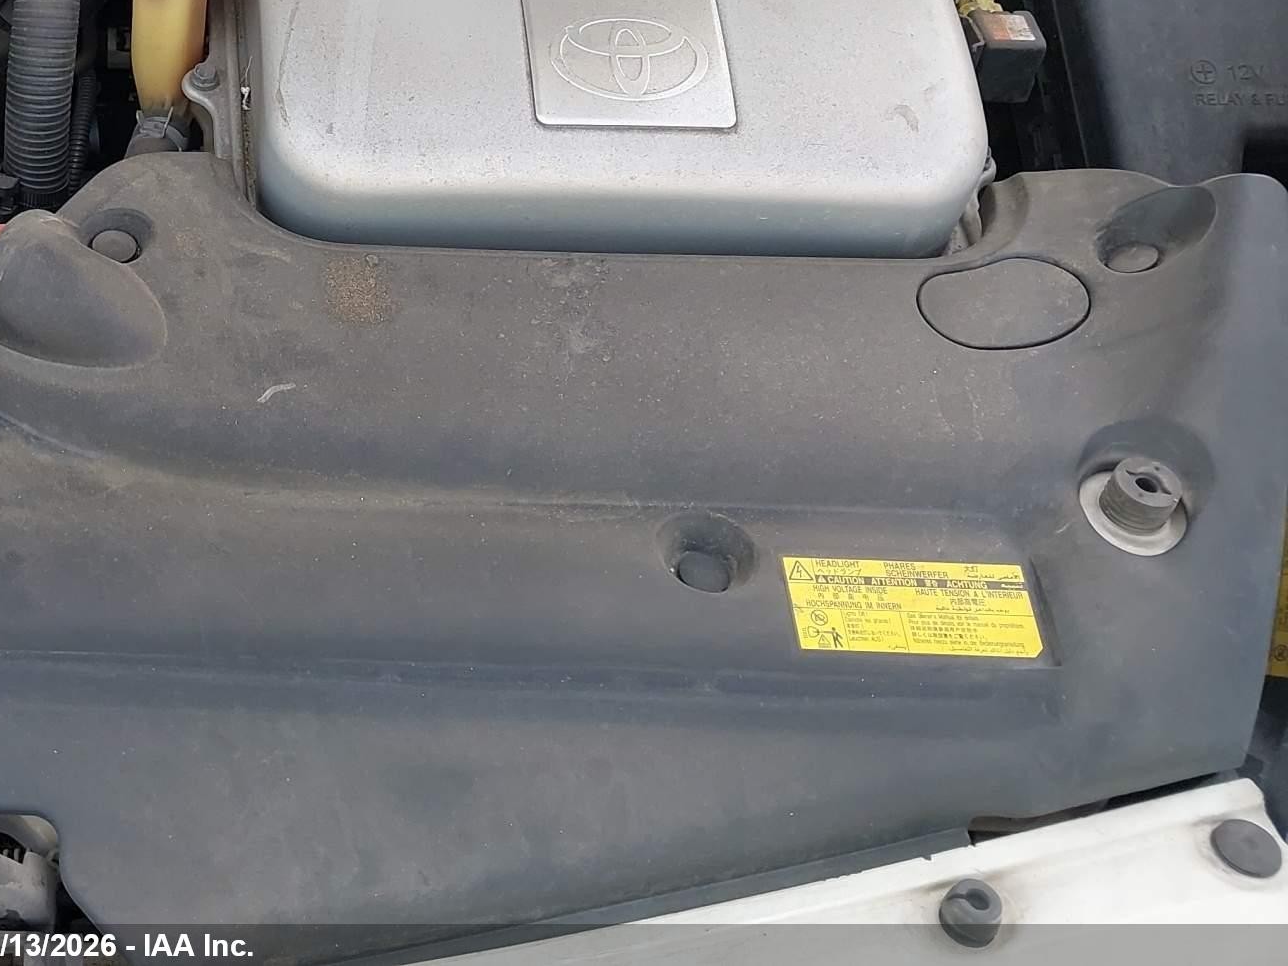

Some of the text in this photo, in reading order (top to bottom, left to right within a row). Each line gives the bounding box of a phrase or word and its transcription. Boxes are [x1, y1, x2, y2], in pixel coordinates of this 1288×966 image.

[1193, 92, 1245, 106] RELAY
[816, 559, 860, 568] HEADLIGHT
[883, 562, 916, 570] PHARES
[885, 570, 948, 579] SCHEINWERFER
[827, 575, 865, 584] CAUTION
[871, 578, 918, 586] ATTENTION
[946, 580, 988, 589] ACHTUNG
[833, 585, 863, 593] VOLTAGE
[865, 586, 888, 594] INSIDE
[915, 588, 938, 596] HAUTE
[941, 589, 970, 597] TENSION
[806, 599, 862, 608] HOCHSPANNUNG
[876, 602, 902, 610] INNERN
